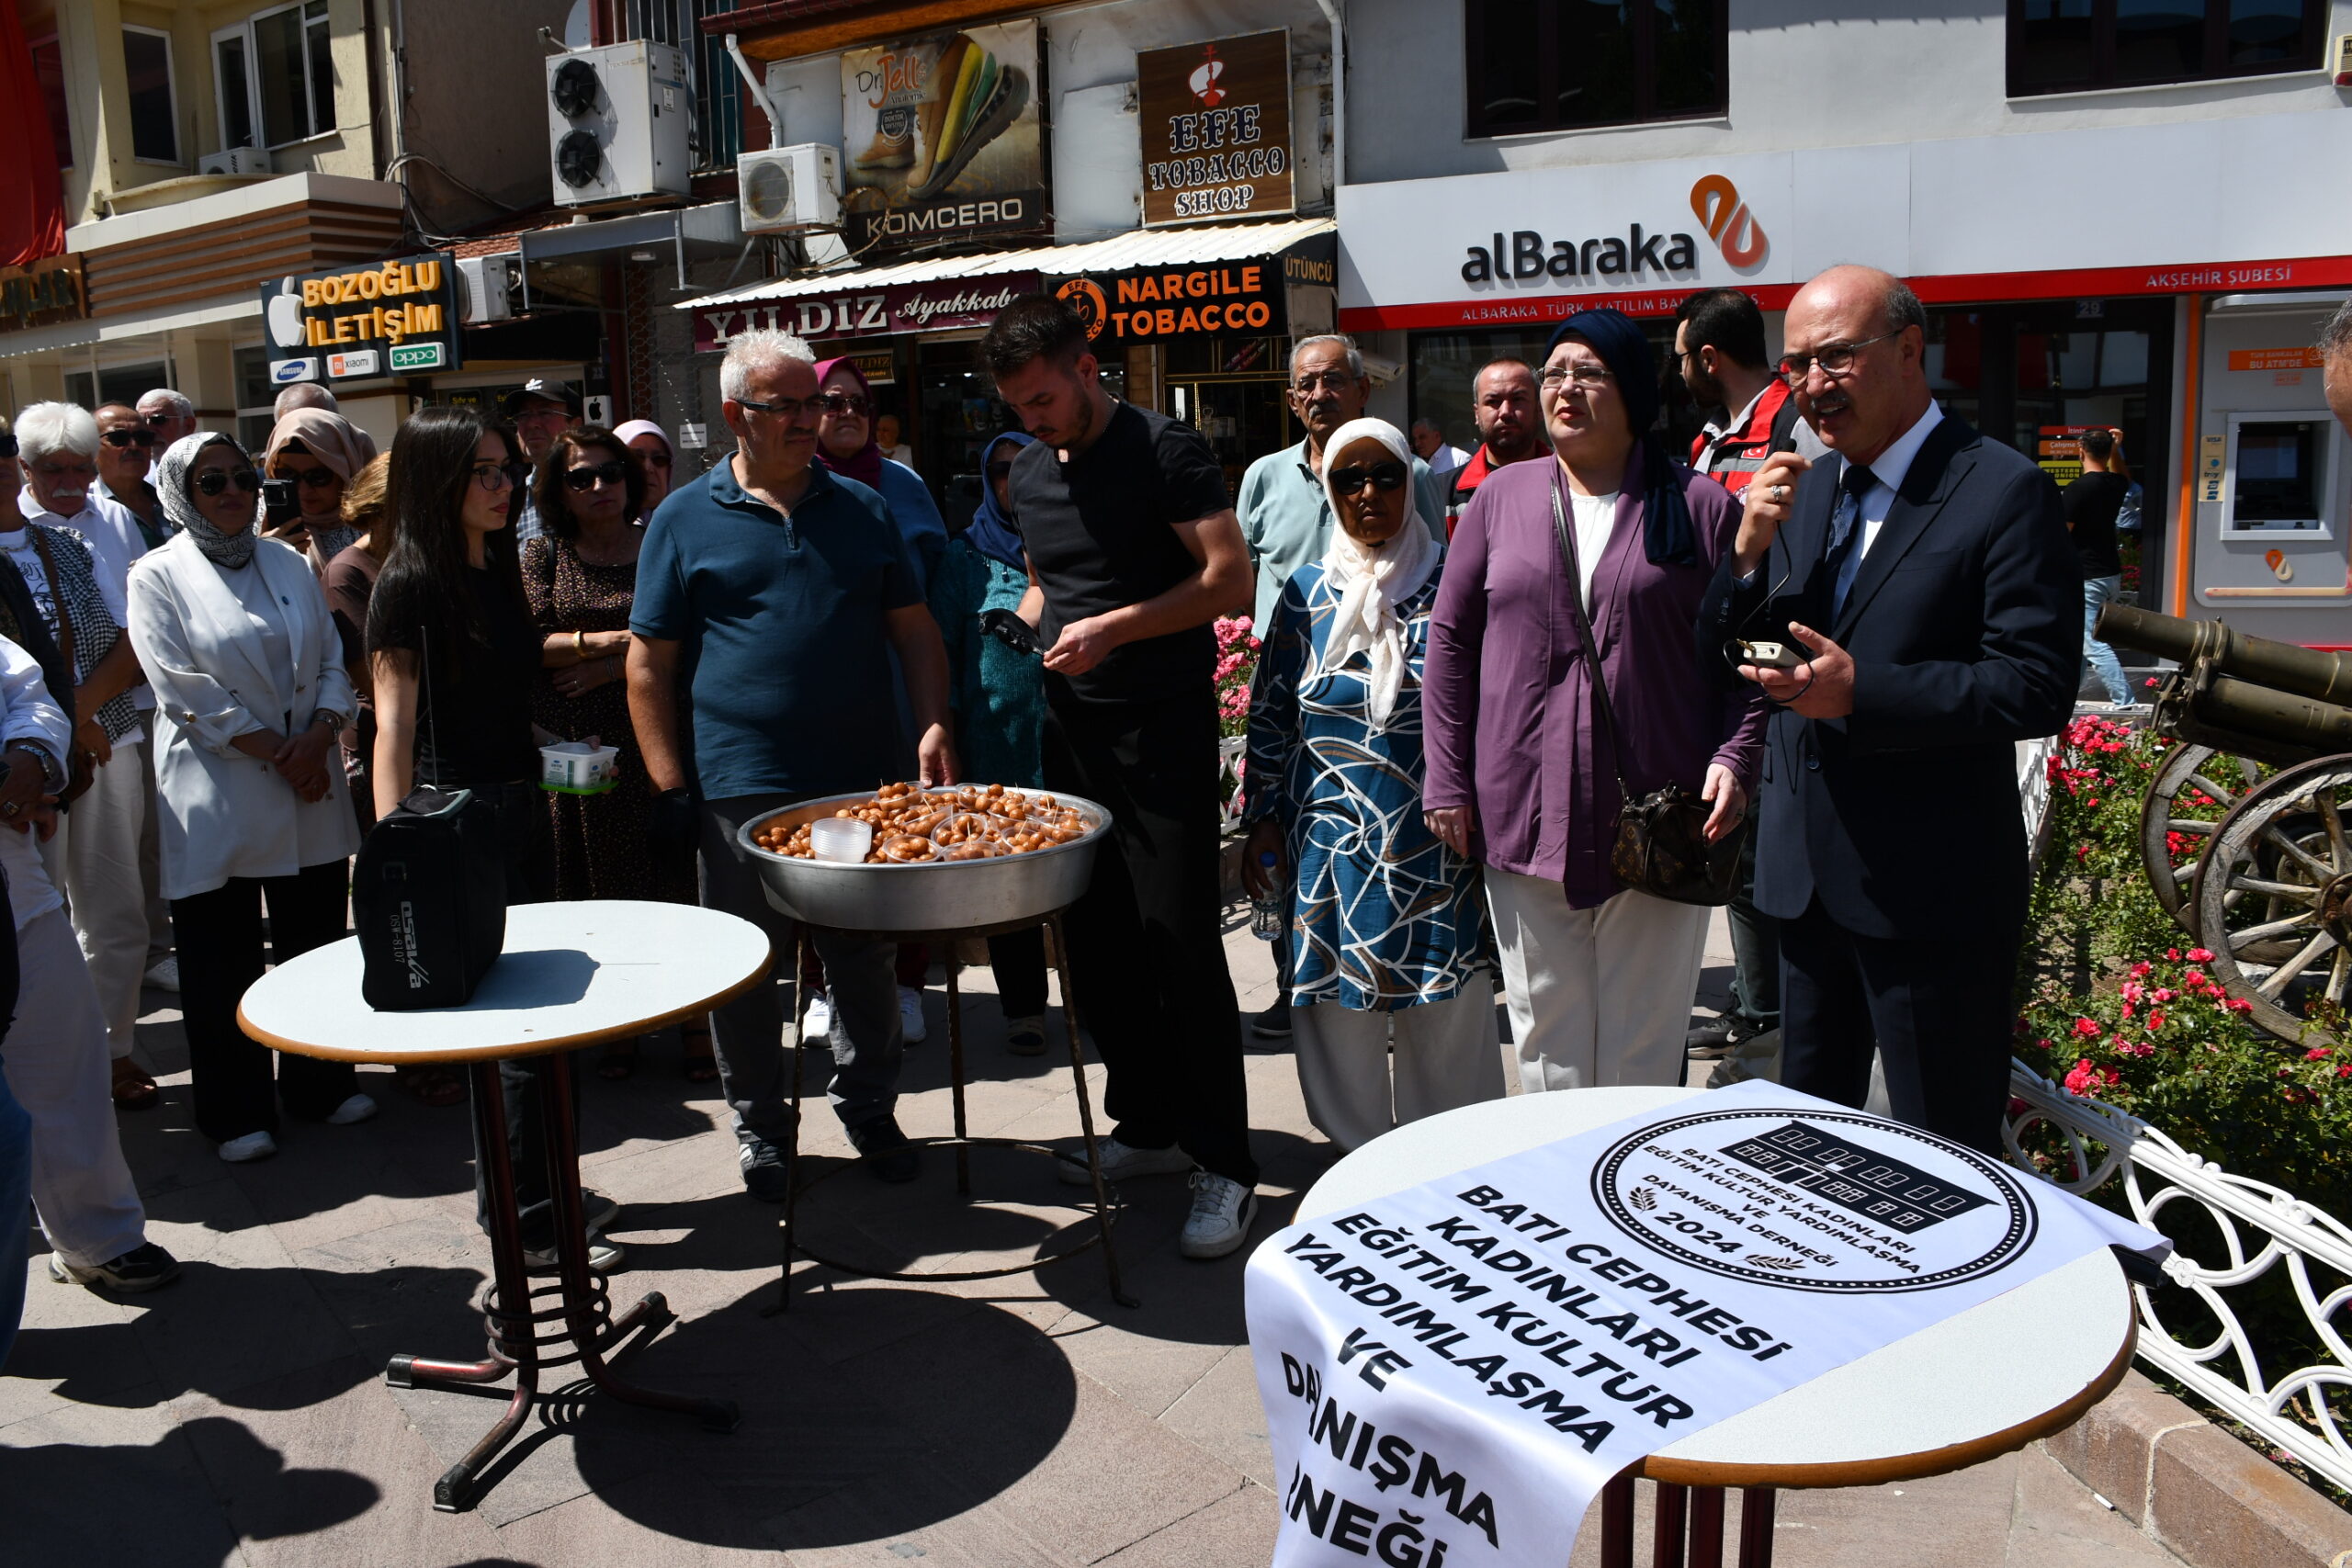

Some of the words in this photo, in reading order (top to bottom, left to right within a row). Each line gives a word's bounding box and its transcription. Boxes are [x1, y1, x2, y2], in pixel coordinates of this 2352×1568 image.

[1170, 103, 1261, 153] EFE
[1149, 146, 1284, 190] TOBACCO
[867, 198, 1023, 238] KOMCERO
[1175, 184, 1254, 217] SHOP
[1285, 253, 1332, 283] ÜTÜNCÜ
[1461, 223, 1696, 283] alBaraka
[302, 260, 441, 308] BOZOĞLU
[1068, 281, 1088, 292] EFE
[2146, 271, 2222, 288] AKŞEHİR
[2228, 265, 2291, 286] ŞUBESİ
[306, 302, 442, 346] İLETİŞİM
[704, 295, 887, 344] YILDIZ
[1112, 300, 1270, 338] TOBACCO
[1462, 304, 1537, 321] ALBARAKA
[1546, 299, 1585, 315] TÜRK
[2079, 301, 2100, 315] 29
[345, 359, 369, 368] xiaomi
[394, 349, 435, 365] oppo
[389, 914, 405, 964] OSW-8107
[1642, 1174, 1746, 1225] DAYANIŞMA
[1746, 1224, 1839, 1268] DERNEĞİ
[1681, 1148, 1724, 1168] BATI
[1802, 1202, 1917, 1254] KADINLARI
[1742, 1203, 1770, 1219] VE
[1653, 1211, 1744, 1255] 2024
[1777, 1204, 1921, 1274] YARDIMLAŞMA
[1331, 1213, 1492, 1303] EĞİTİM
[1456, 1184, 1571, 1244] BATI
[1566, 1243, 1793, 1361] CEPHESİ
[1426, 1216, 1702, 1369] KADINLARI
[1283, 1233, 1615, 1455] YARDIMLAŞMA
[1337, 1327, 1414, 1393] VE
